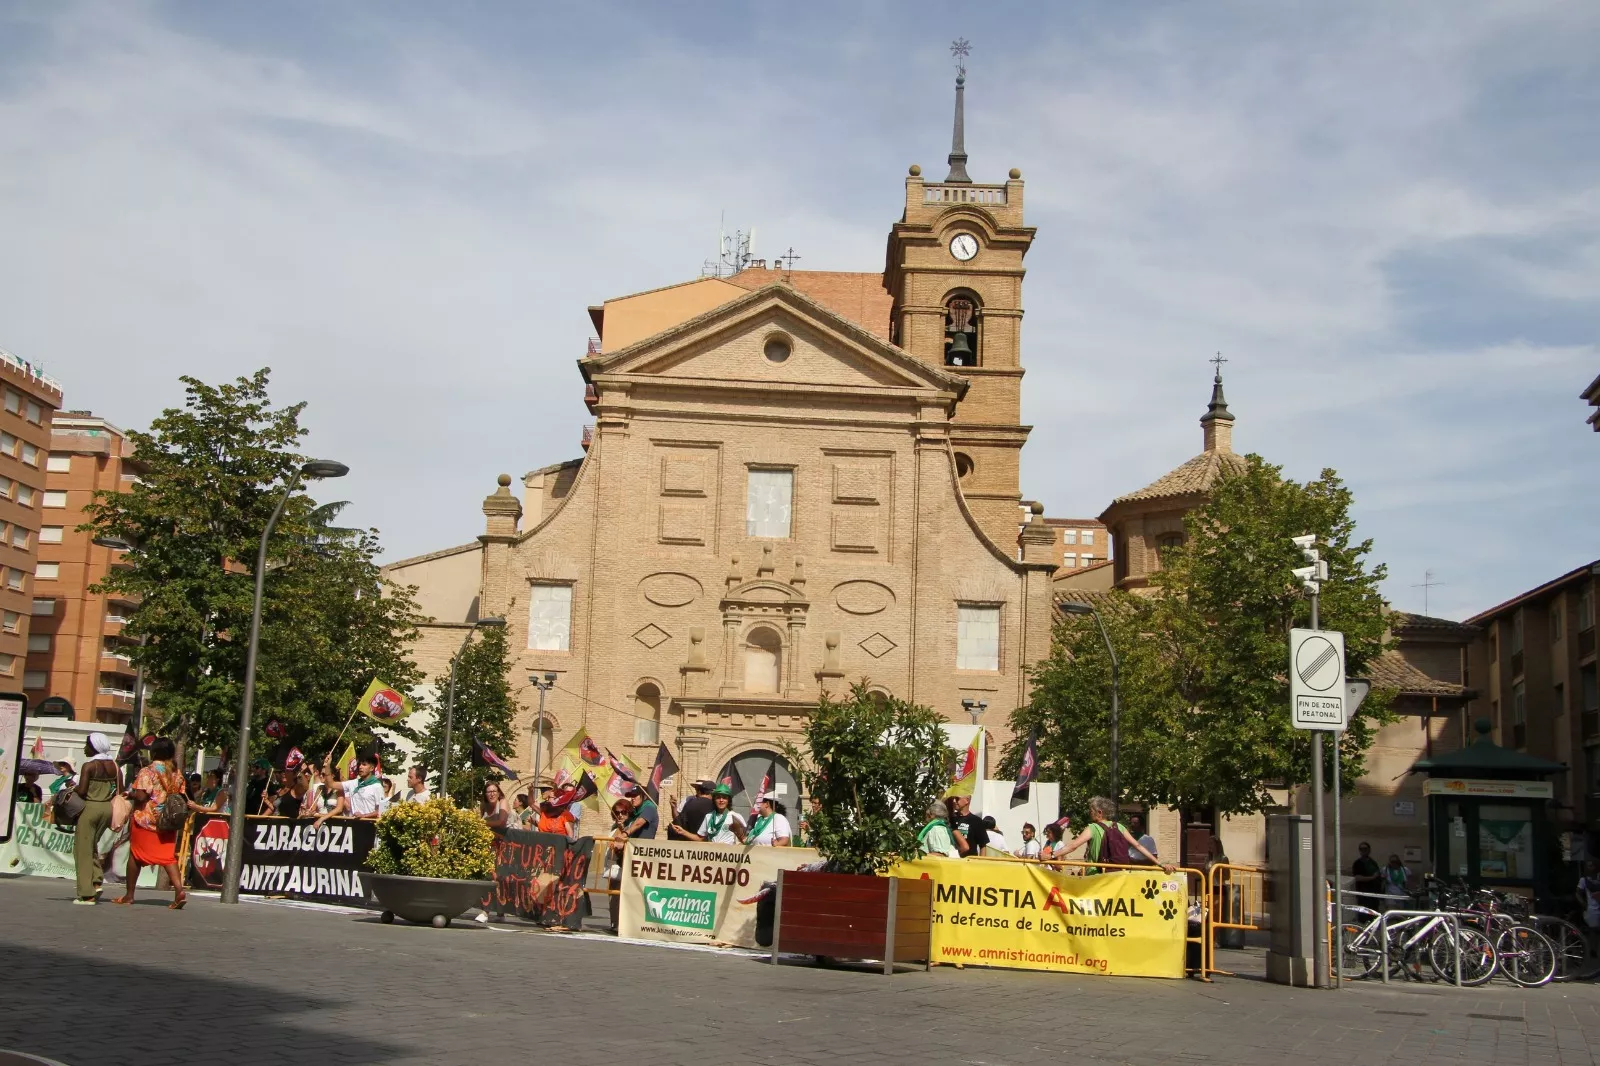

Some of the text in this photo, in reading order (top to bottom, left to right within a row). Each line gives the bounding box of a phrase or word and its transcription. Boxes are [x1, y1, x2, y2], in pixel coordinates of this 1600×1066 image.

[1302, 710, 1337, 718] PEATONAL
[17, 826, 33, 845] DE
[32, 829, 46, 848] LA
[254, 824, 354, 854] ZARAGOZA
[488, 841, 556, 872] RTURA
[632, 846, 672, 859] DEJEMOS
[673, 849, 684, 860] LA
[240, 864, 364, 897] ANTITAURINA
[631, 860, 750, 887] EN EL PASADO
[667, 894, 711, 912] anima
[932, 881, 1144, 918] MNISTIA ANIMAL
[664, 910, 710, 925] naturalis
[950, 911, 1009, 929] defensa
[1016, 917, 1033, 931] de
[1039, 919, 1060, 933] los
[1067, 923, 1126, 938] animales
[640, 925, 716, 940] www.AnimaNaturalisorg
[941, 945, 1108, 971] www.amnistiaanimal.org
